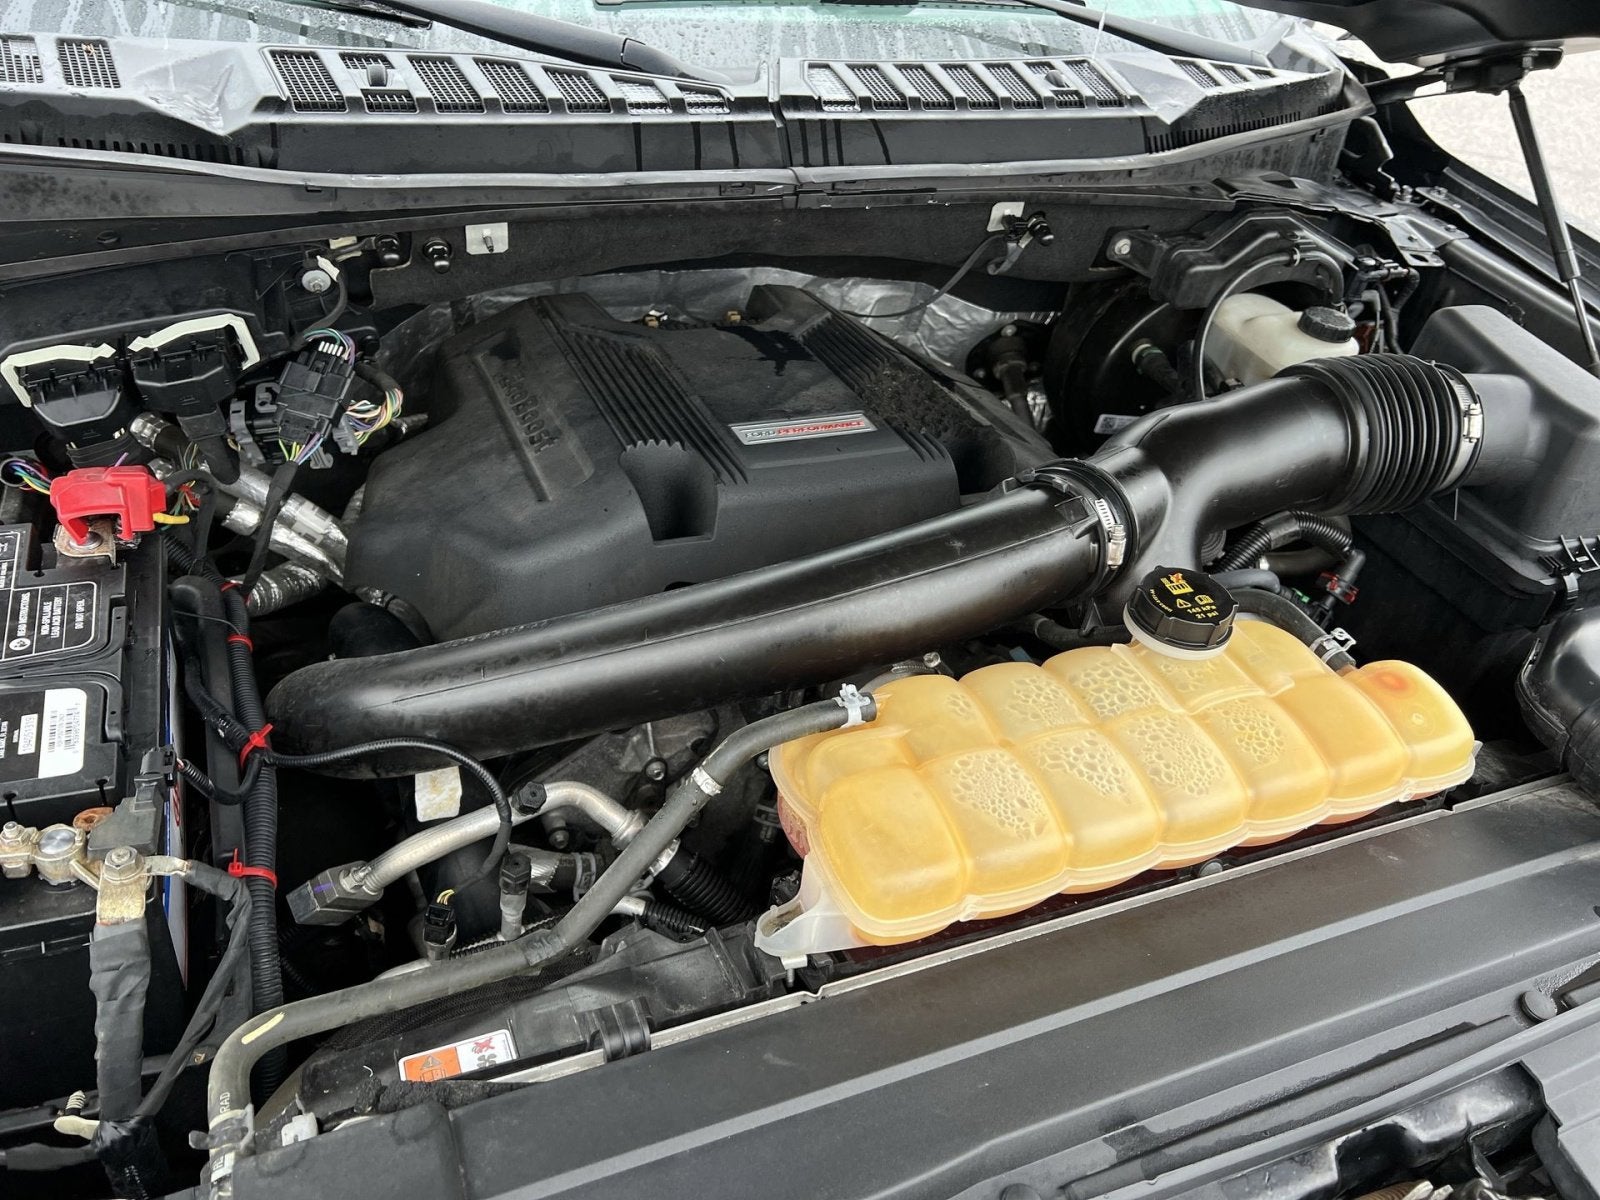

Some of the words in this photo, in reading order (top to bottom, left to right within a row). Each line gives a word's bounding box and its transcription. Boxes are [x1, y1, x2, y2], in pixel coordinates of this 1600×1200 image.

[744, 430, 776, 438] FORD
[776, 420, 865, 435] PERFORMANCE
[220, 1091, 230, 1113] RAD
